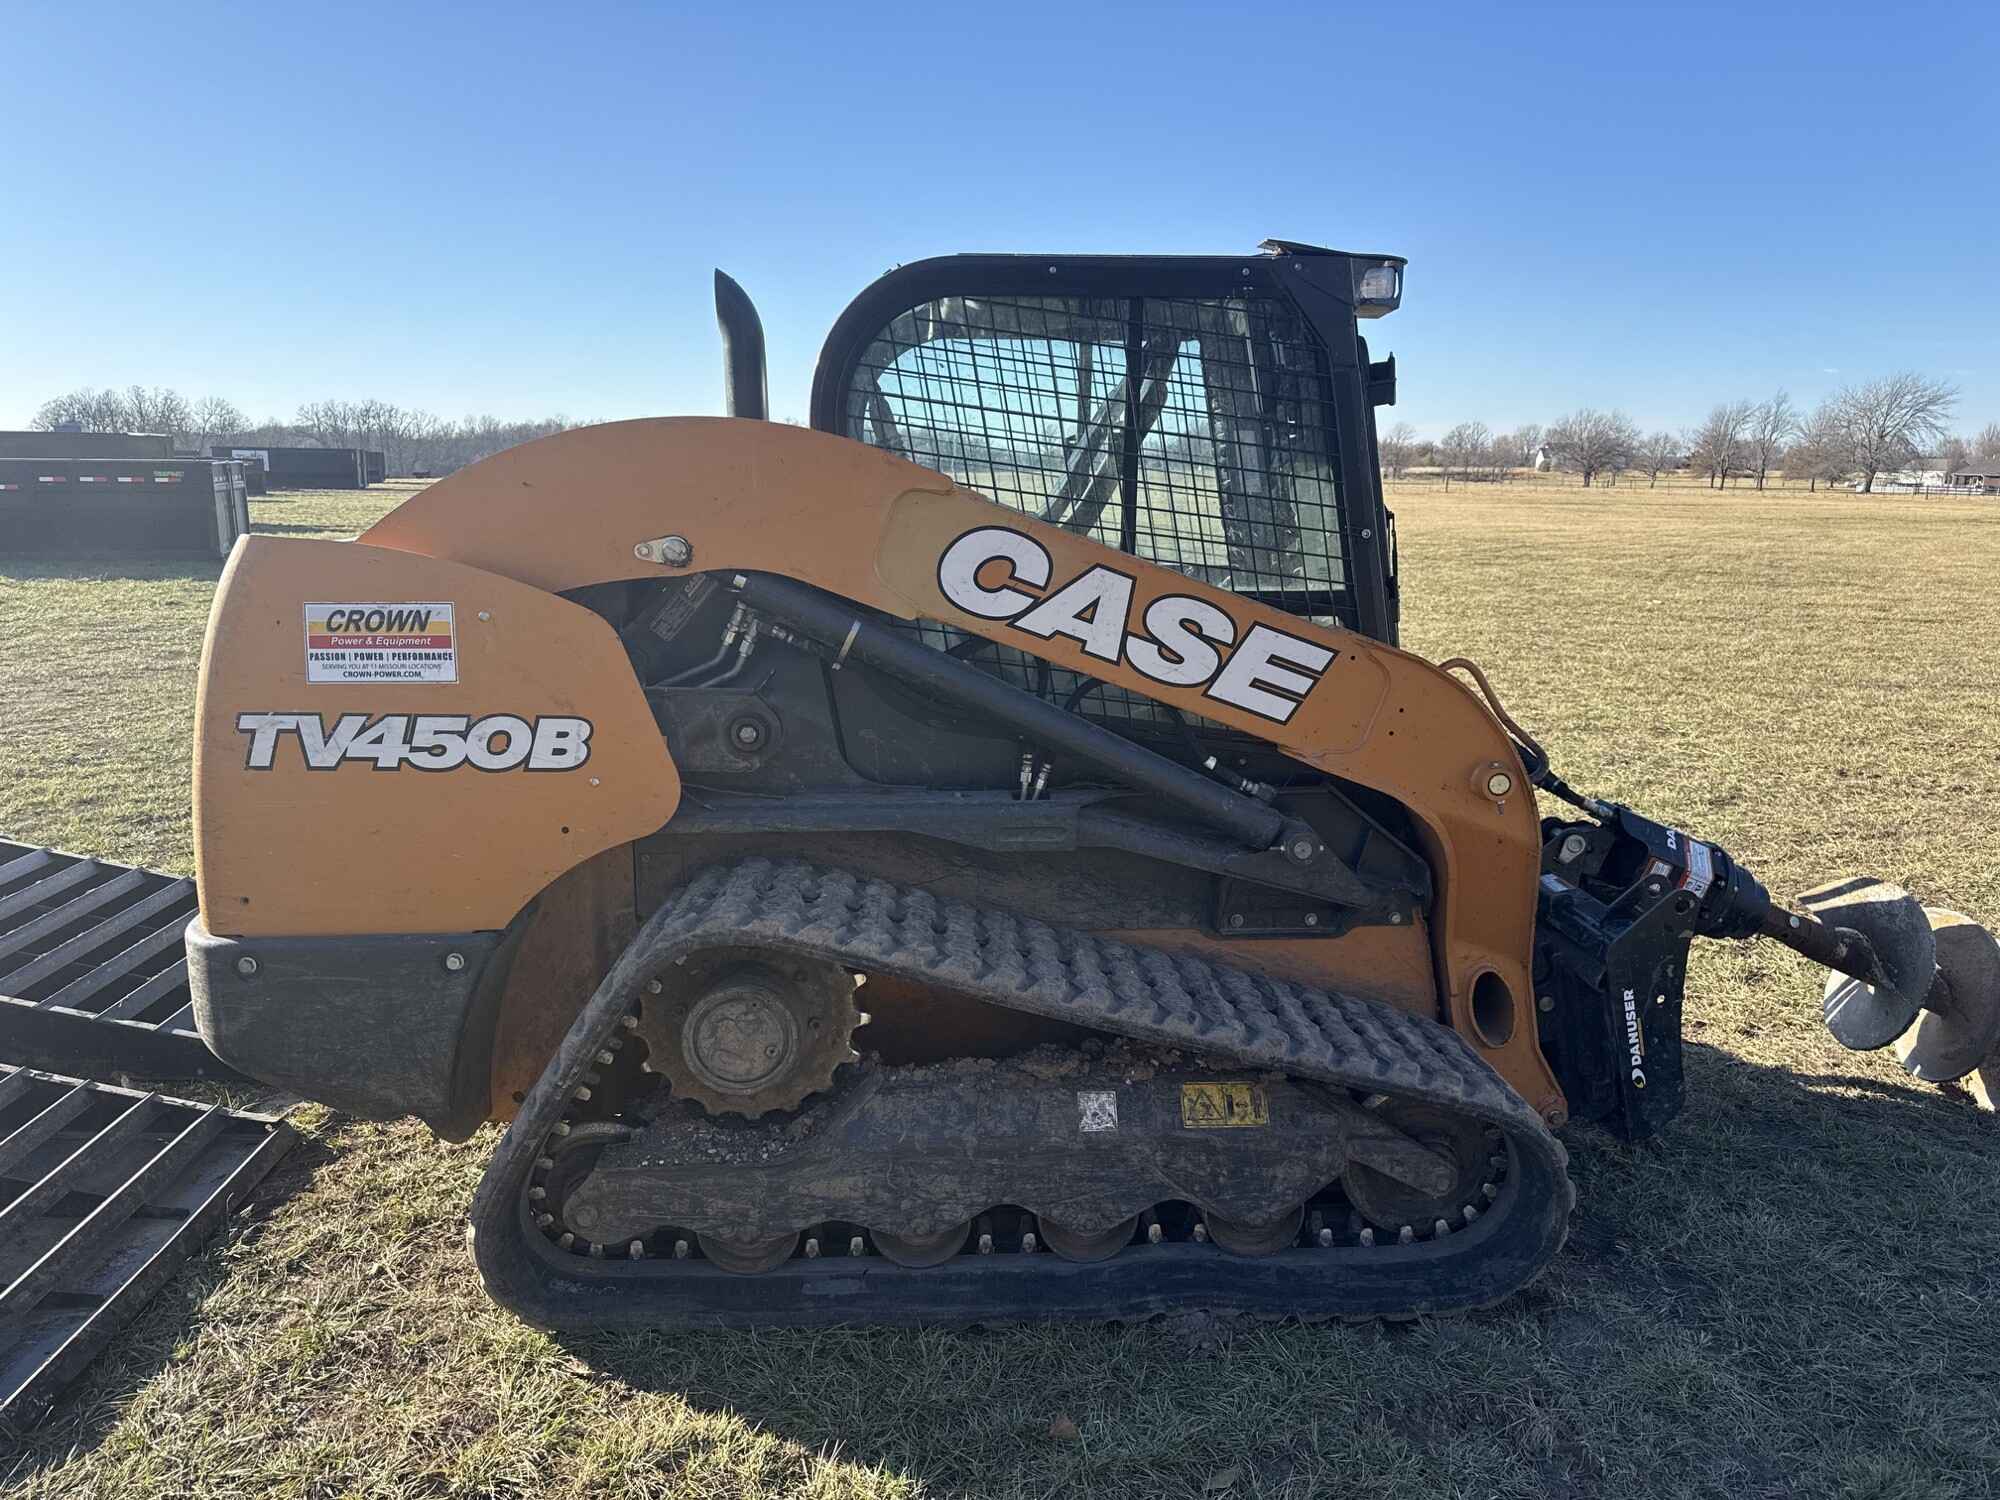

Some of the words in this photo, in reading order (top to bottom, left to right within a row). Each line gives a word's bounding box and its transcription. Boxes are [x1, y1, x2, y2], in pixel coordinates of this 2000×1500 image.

[326, 609, 432, 632] CROWN
[330, 636, 363, 646] Power
[365, 636, 372, 645] &
[375, 636, 432, 647] Equipment
[937, 525, 1340, 726] CASE
[309, 652, 346, 661] PASSION
[353, 652, 384, 661] POWER
[391, 652, 453, 661] PERFORMANCE
[236, 711, 594, 773] TV450B
[1623, 988, 1642, 1066] DANUSER
